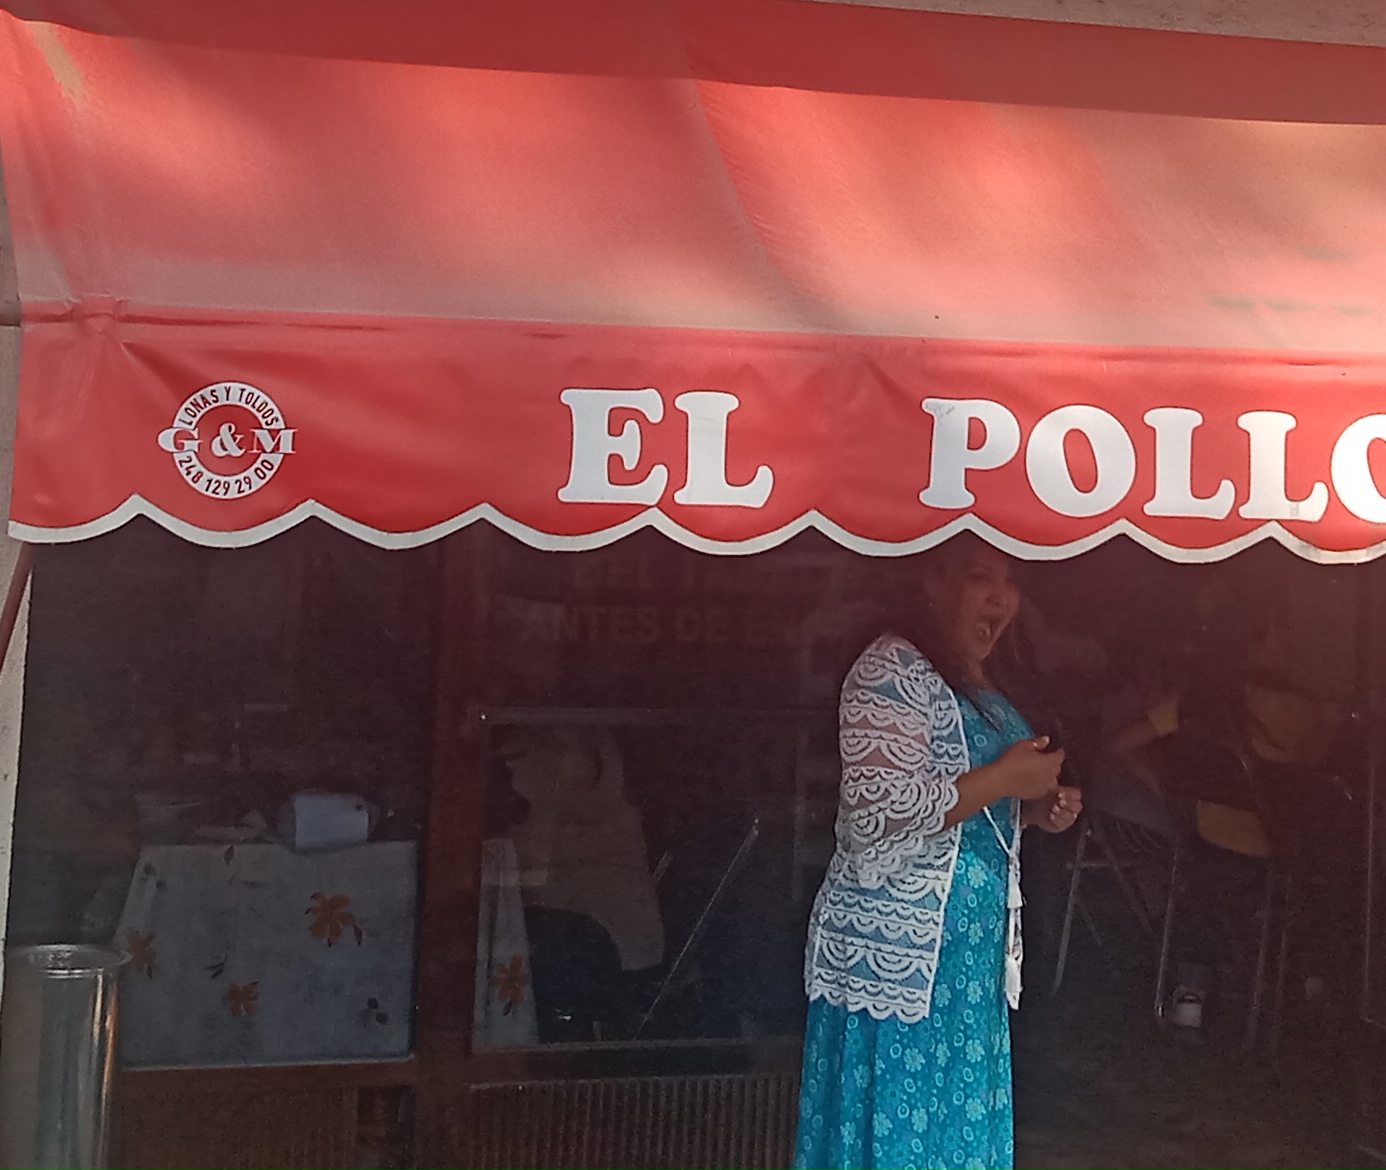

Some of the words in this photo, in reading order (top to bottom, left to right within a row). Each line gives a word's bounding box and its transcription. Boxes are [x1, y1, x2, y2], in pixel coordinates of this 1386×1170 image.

[178, 389, 219, 426] LONAS
[224, 386, 231, 401] Y
[238, 388, 280, 426] TOLDOS
[157, 427, 203, 454] G
[211, 423, 246, 457] &
[248, 428, 298, 454] M
[557, 387, 774, 508] EL
[205, 478, 230, 496] 129
[234, 476, 253, 494] 29
[254, 458, 274, 480] 00
